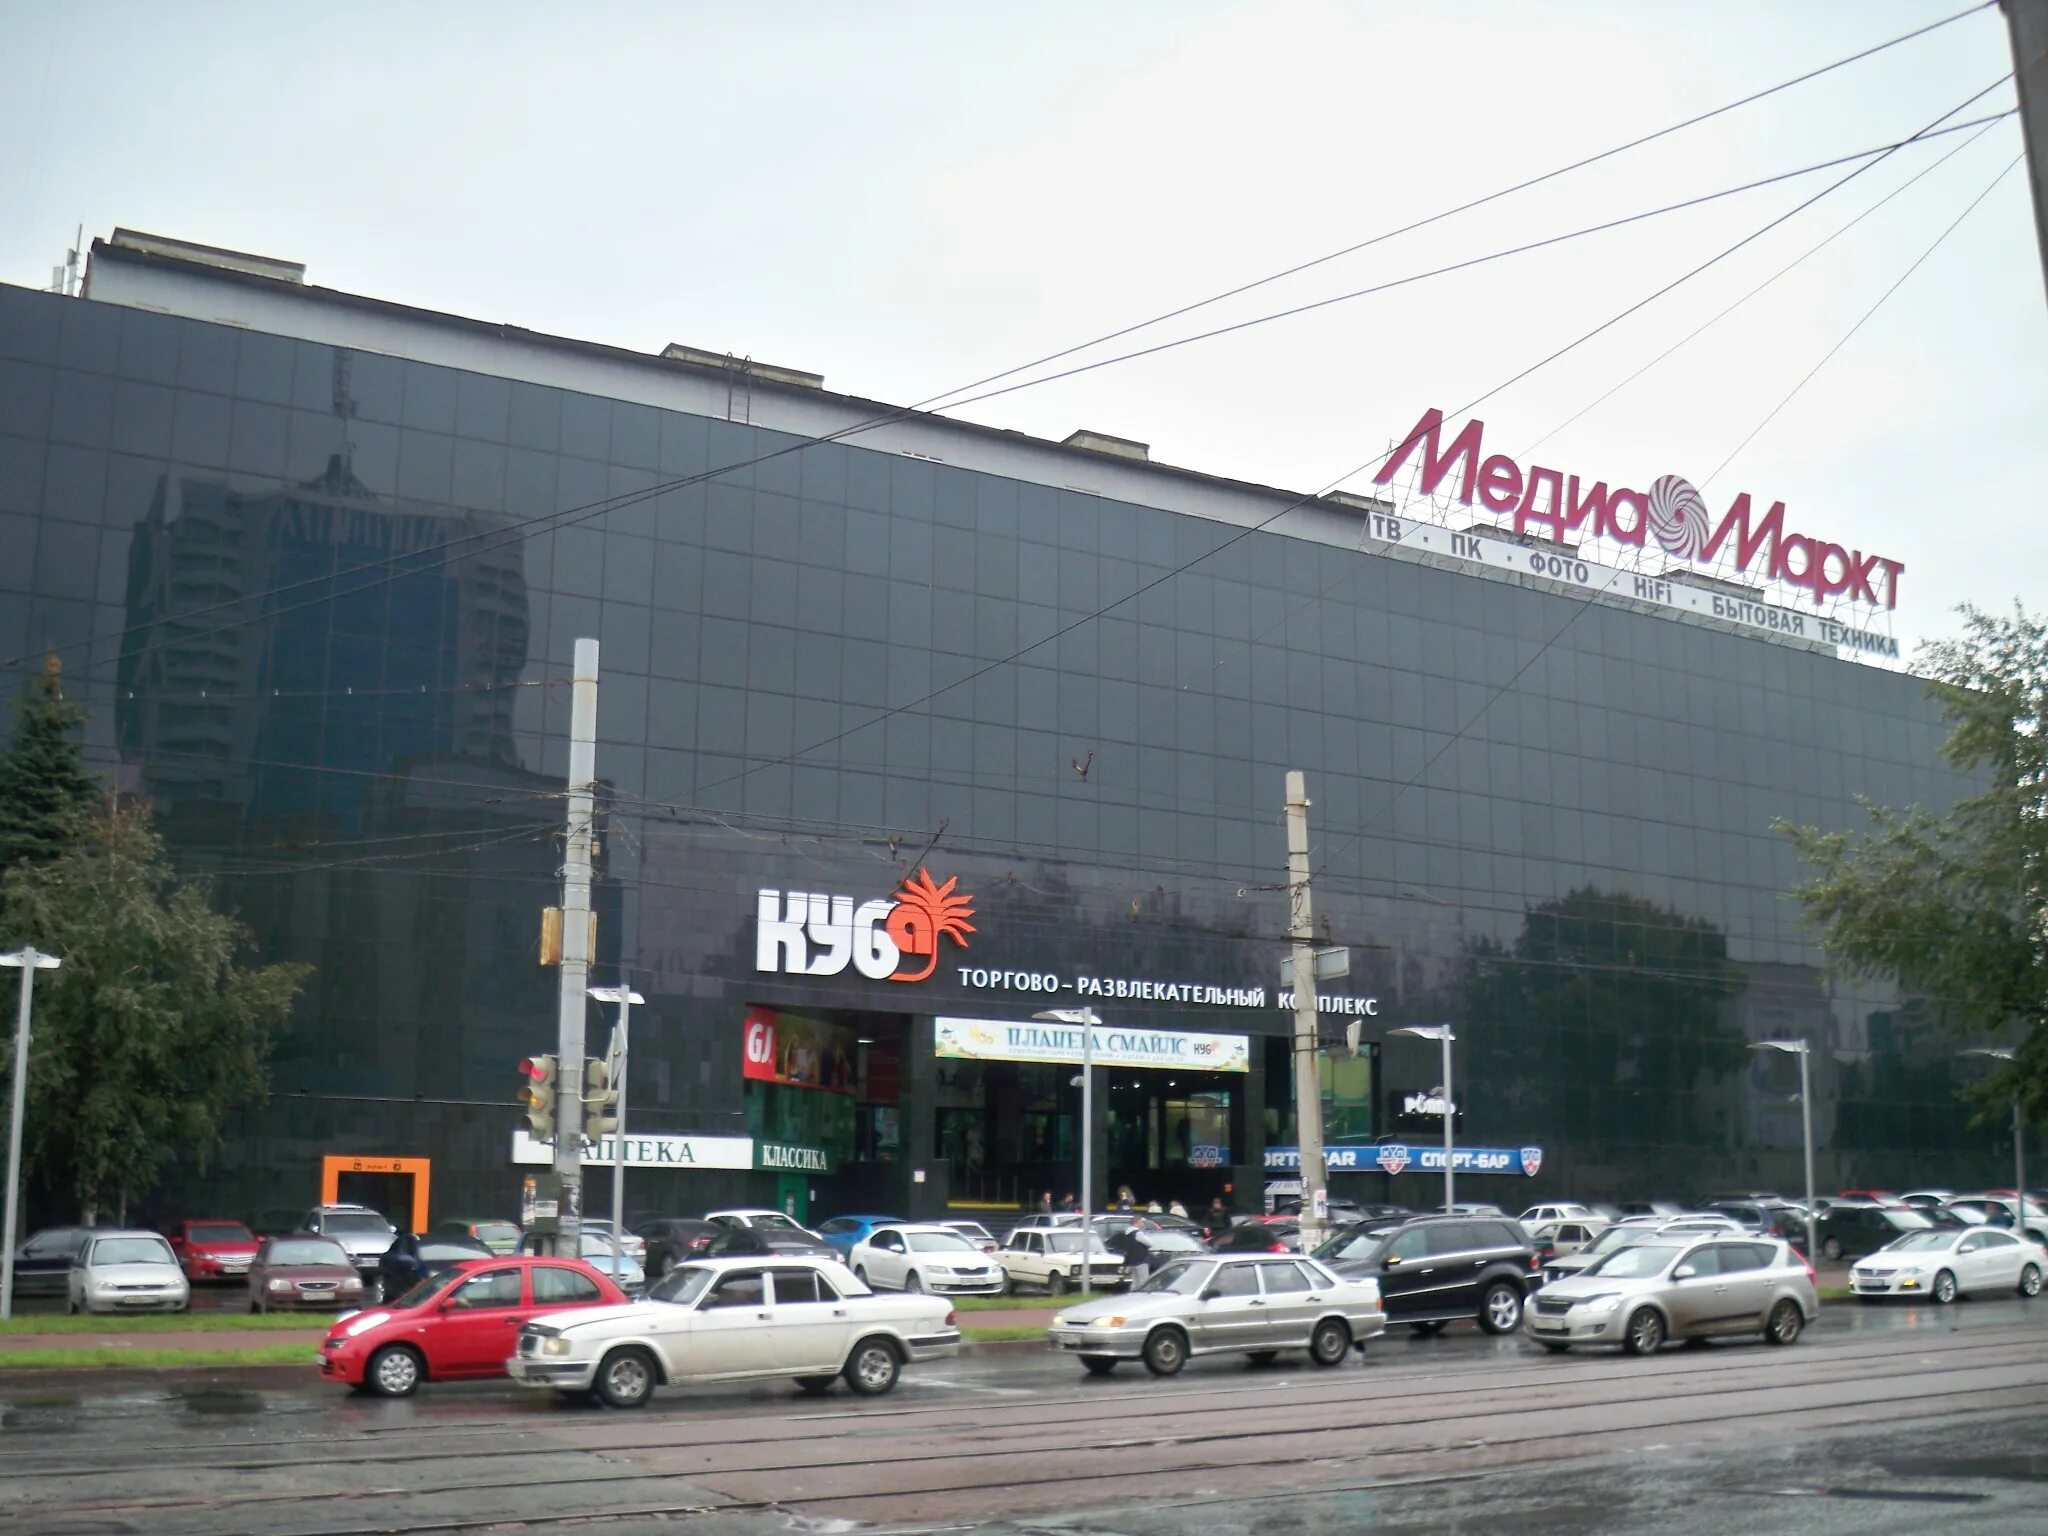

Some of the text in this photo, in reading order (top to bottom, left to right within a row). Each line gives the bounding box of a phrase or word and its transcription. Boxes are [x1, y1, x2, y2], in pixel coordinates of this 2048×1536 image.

[1371, 407, 1905, 611] Медиа Маркт
[1372, 515, 1899, 658] ТВ ПК ФОТО HiFi БЫТОВАЯ ТЕХНИКА
[1278, 992, 1378, 1016] КПЛЕКС
[1108, 1032, 1188, 1056] СМАЙЛС
[762, 1145, 828, 1170] КЛАССИКА
